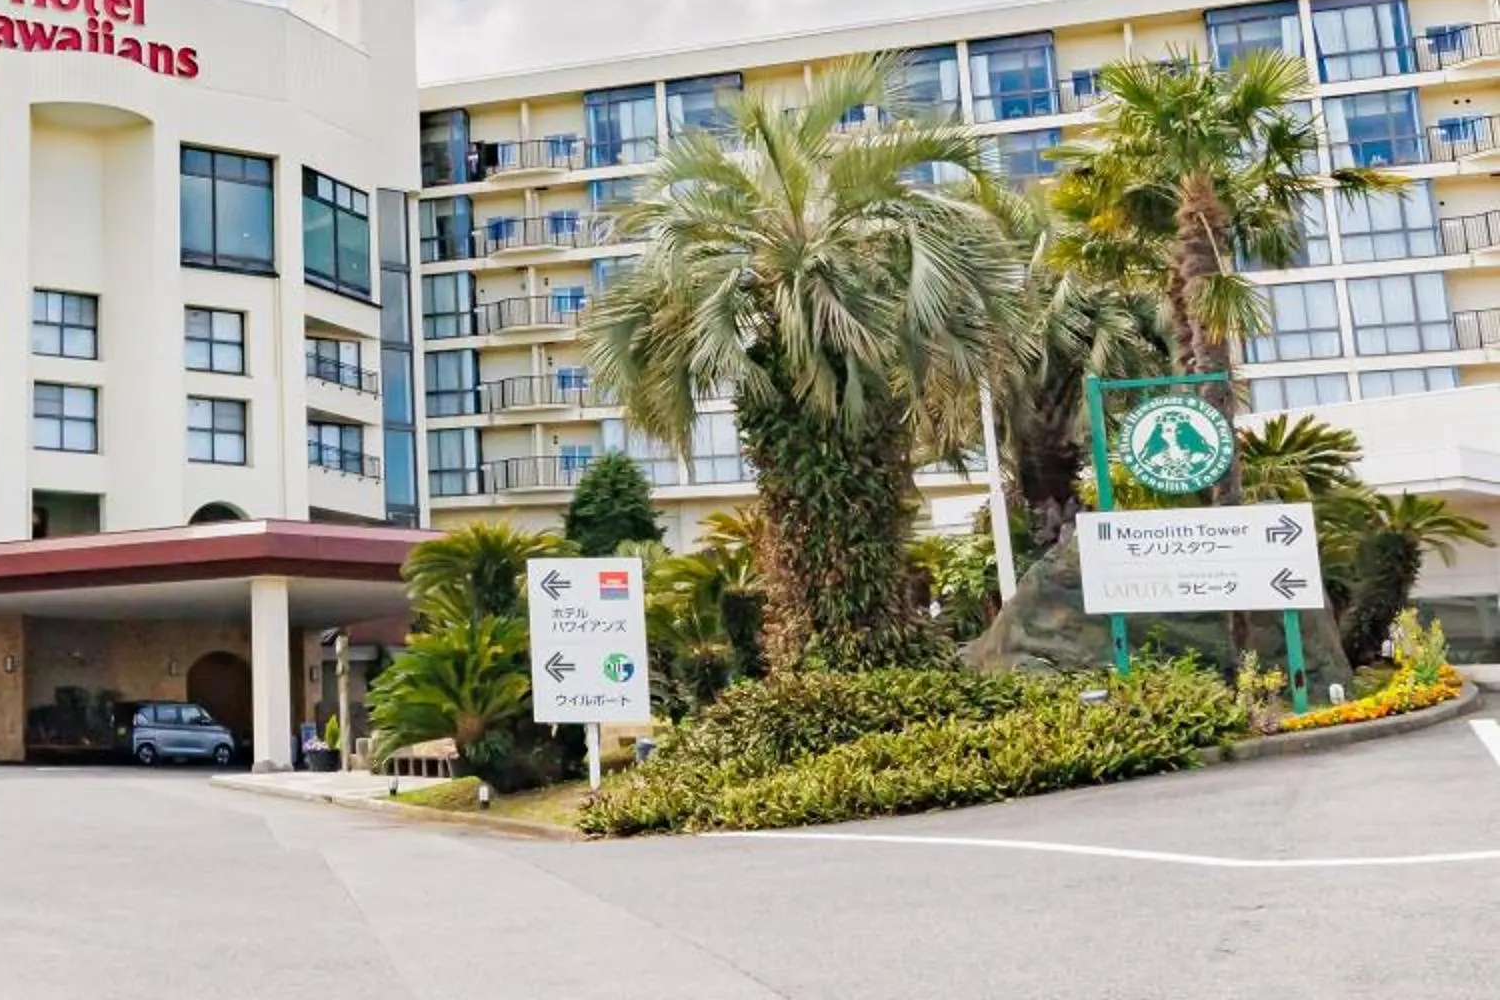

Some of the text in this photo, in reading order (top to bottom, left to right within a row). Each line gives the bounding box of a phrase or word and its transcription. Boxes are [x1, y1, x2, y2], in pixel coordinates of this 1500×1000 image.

[1116, 523, 1249, 540] Monolith Tower
[1126, 541, 1233, 557] モノリスタワー
[552, 608, 588, 619] ホテル
[552, 619, 627, 632] ハワイアンズ
